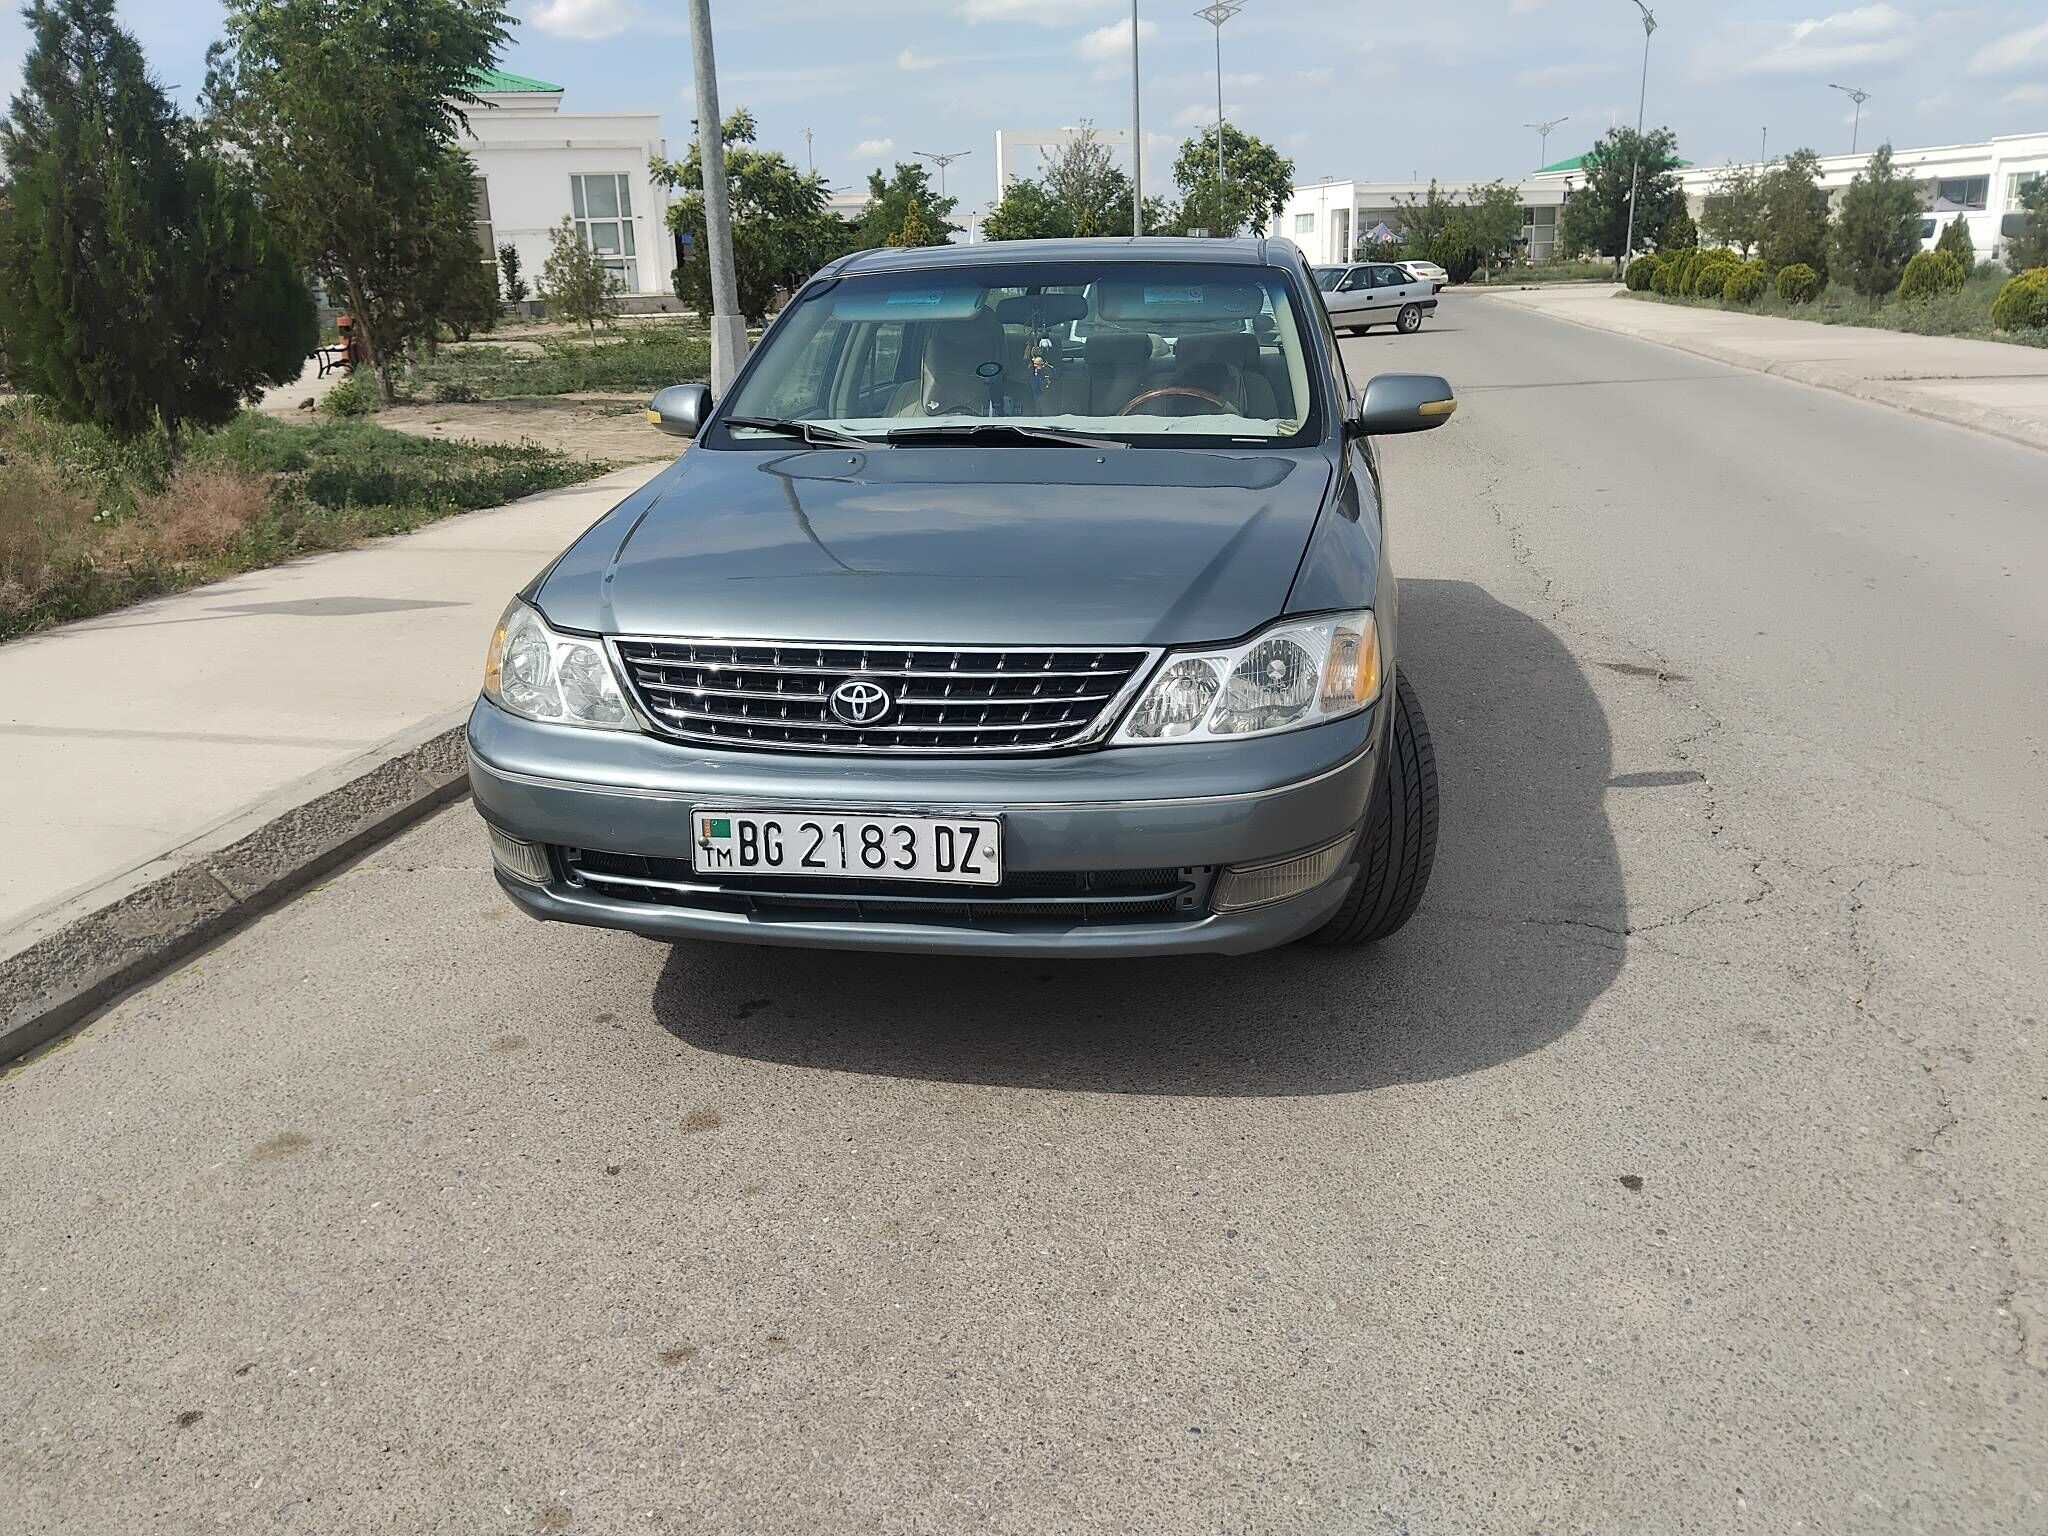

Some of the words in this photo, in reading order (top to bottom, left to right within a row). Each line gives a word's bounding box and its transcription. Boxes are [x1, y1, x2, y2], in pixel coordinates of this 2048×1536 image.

[702, 847, 732, 867] TM
[739, 821, 783, 866] BG
[800, 822, 917, 870] 2183
[934, 825, 981, 874] DZ
